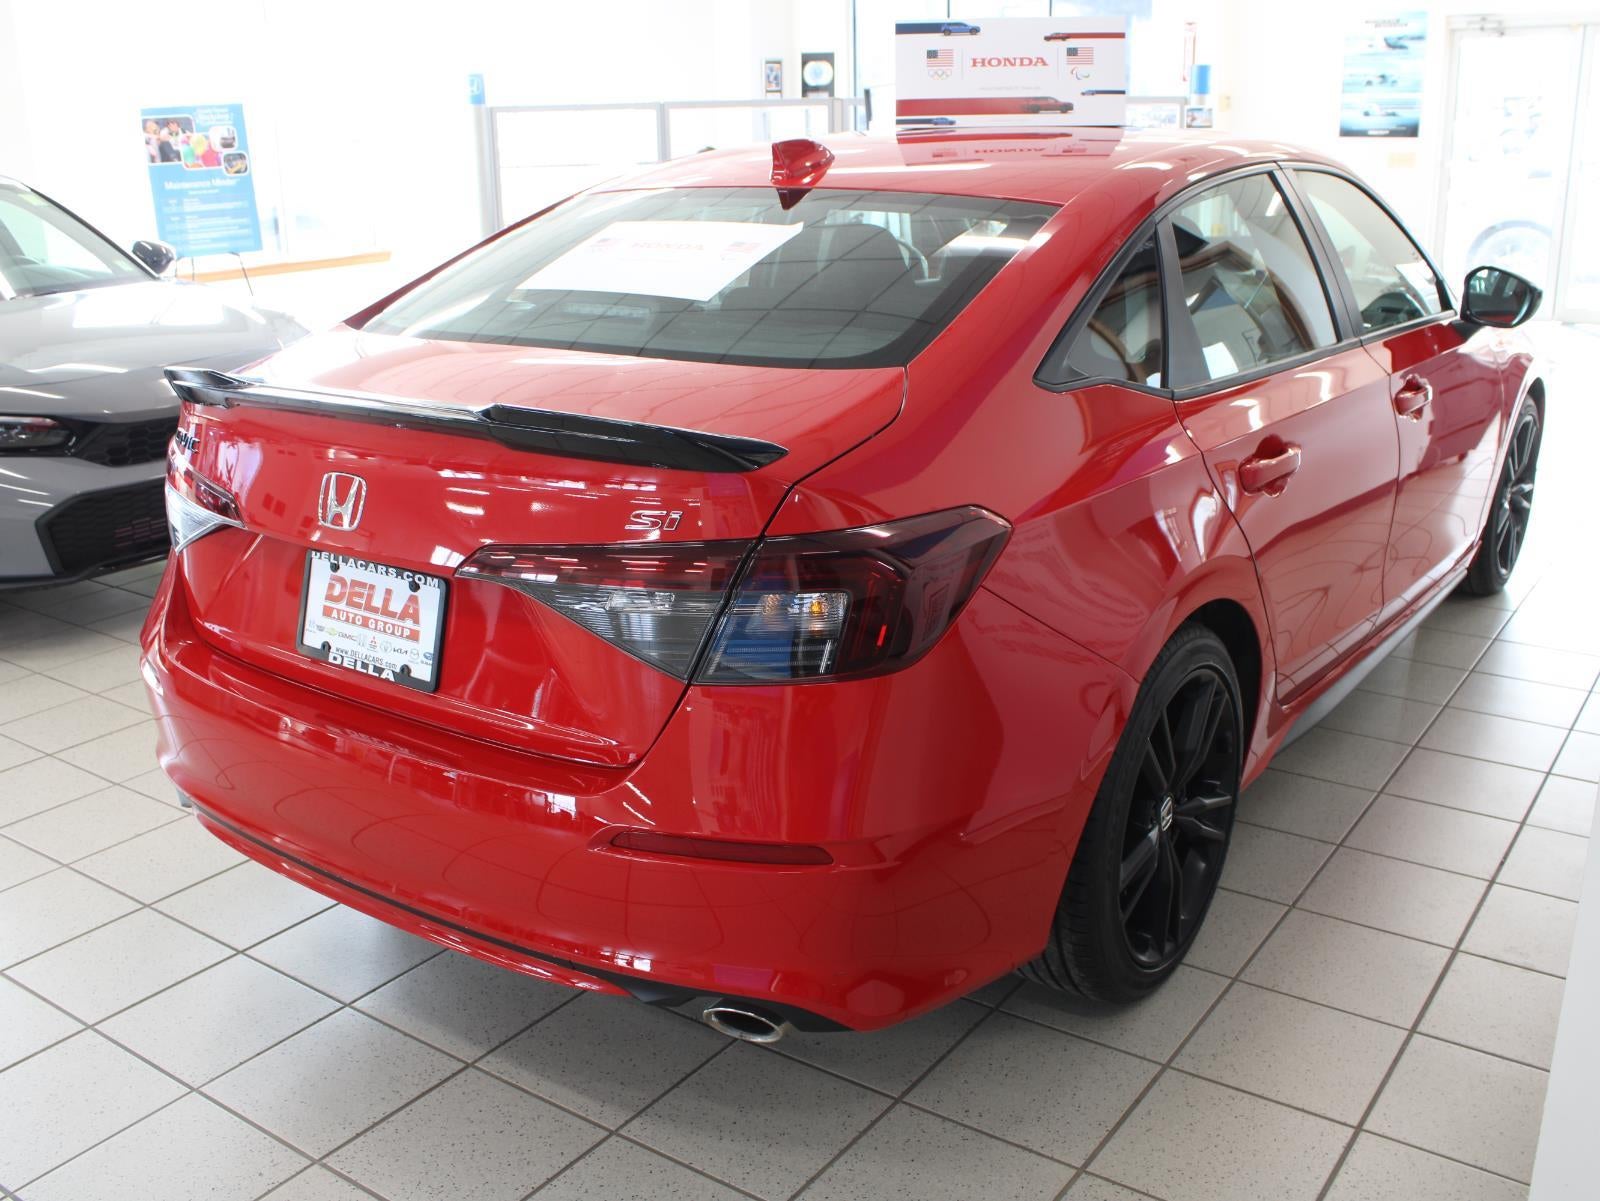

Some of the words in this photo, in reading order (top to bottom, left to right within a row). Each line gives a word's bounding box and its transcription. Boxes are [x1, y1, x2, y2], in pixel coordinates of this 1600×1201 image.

[971, 57, 1048, 67] HONDA
[624, 510, 683, 530] Si
[311, 551, 439, 588] DELLACARS.COM
[324, 573, 420, 625] DELLA
[331, 609, 363, 626] AUTO
[368, 618, 411, 638] GROUP
[328, 652, 396, 681] DELLA
[335, 647, 398, 670] www.DELLACARS.com
